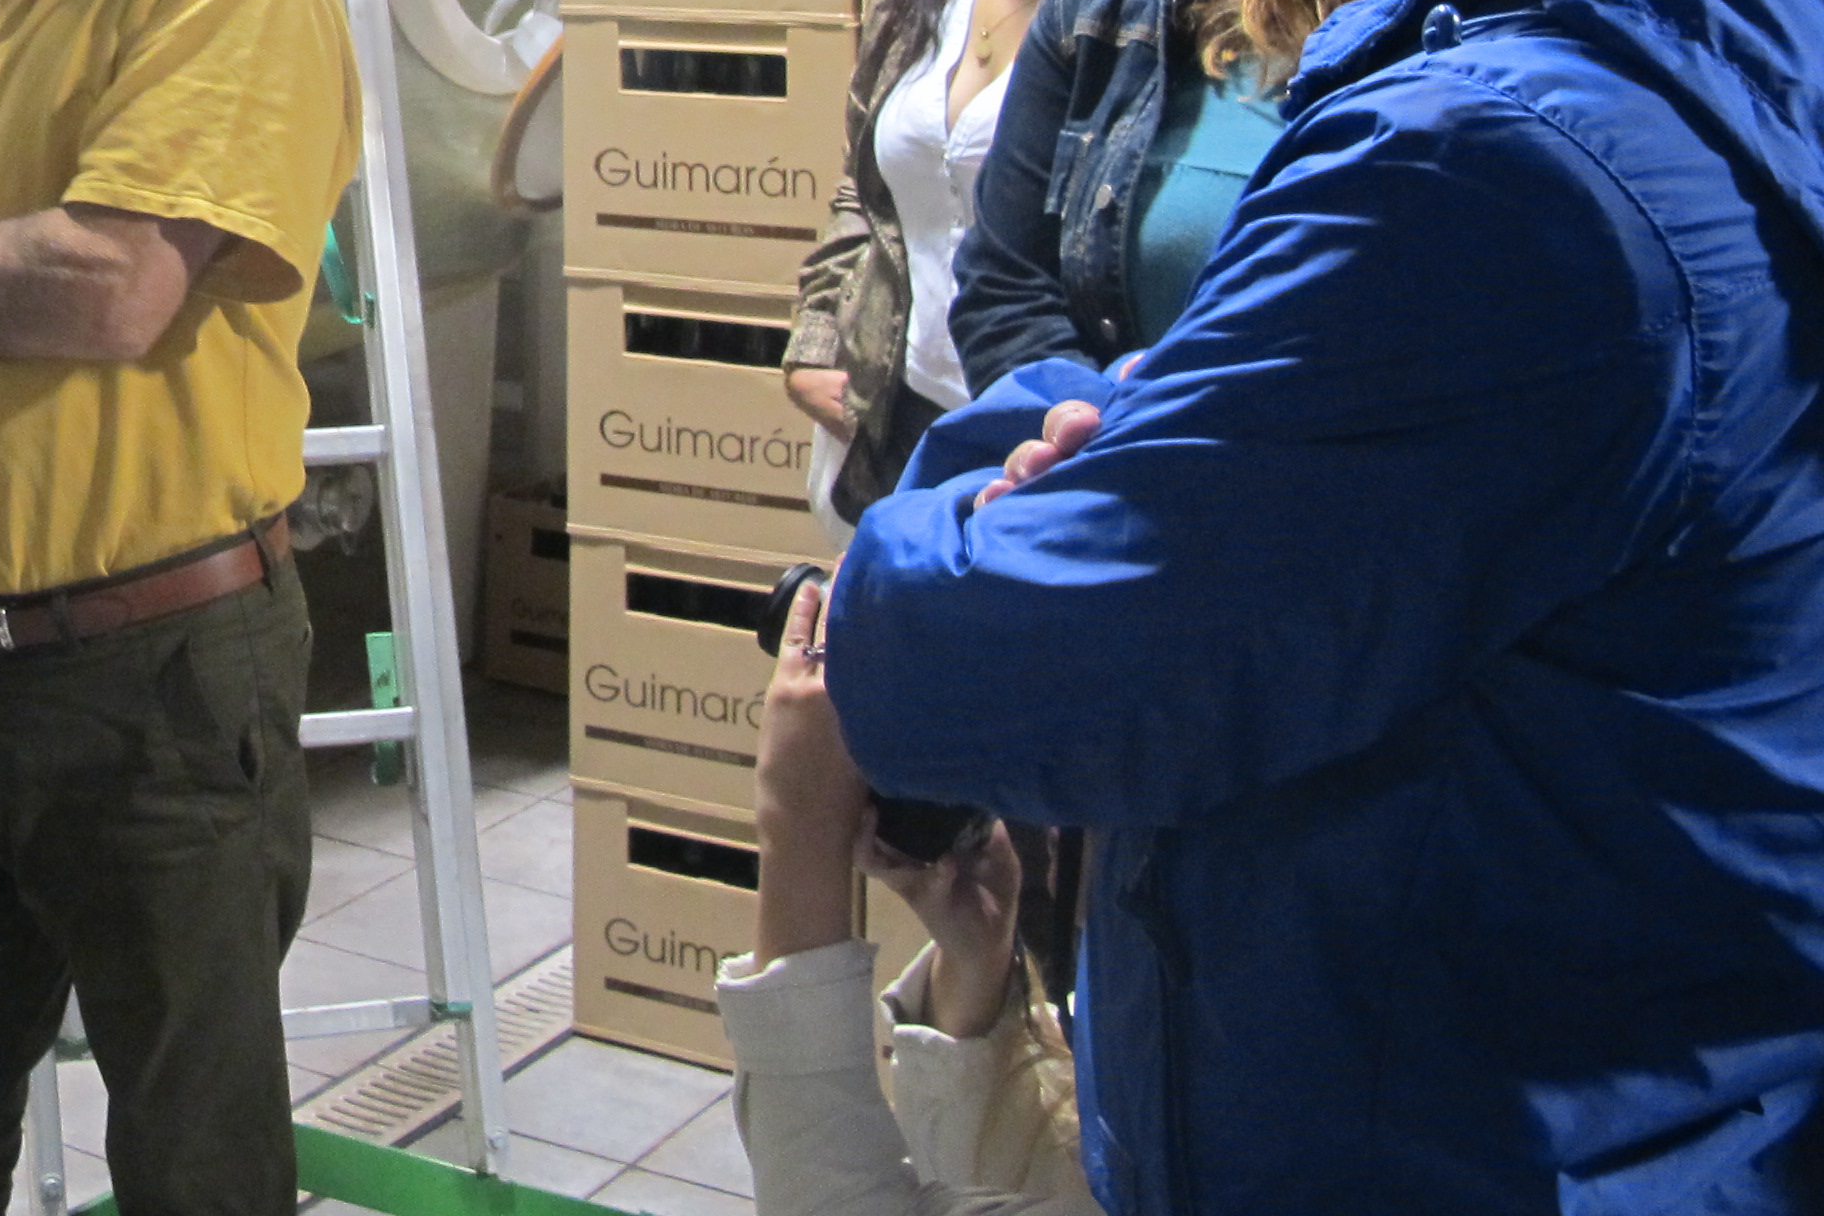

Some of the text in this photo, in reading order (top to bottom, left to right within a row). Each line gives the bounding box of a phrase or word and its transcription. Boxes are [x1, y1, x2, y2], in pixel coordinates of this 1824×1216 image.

[594, 148, 816, 200] Guimarán
[585, 664, 766, 730] Guimar
[604, 917, 738, 976] Guim
